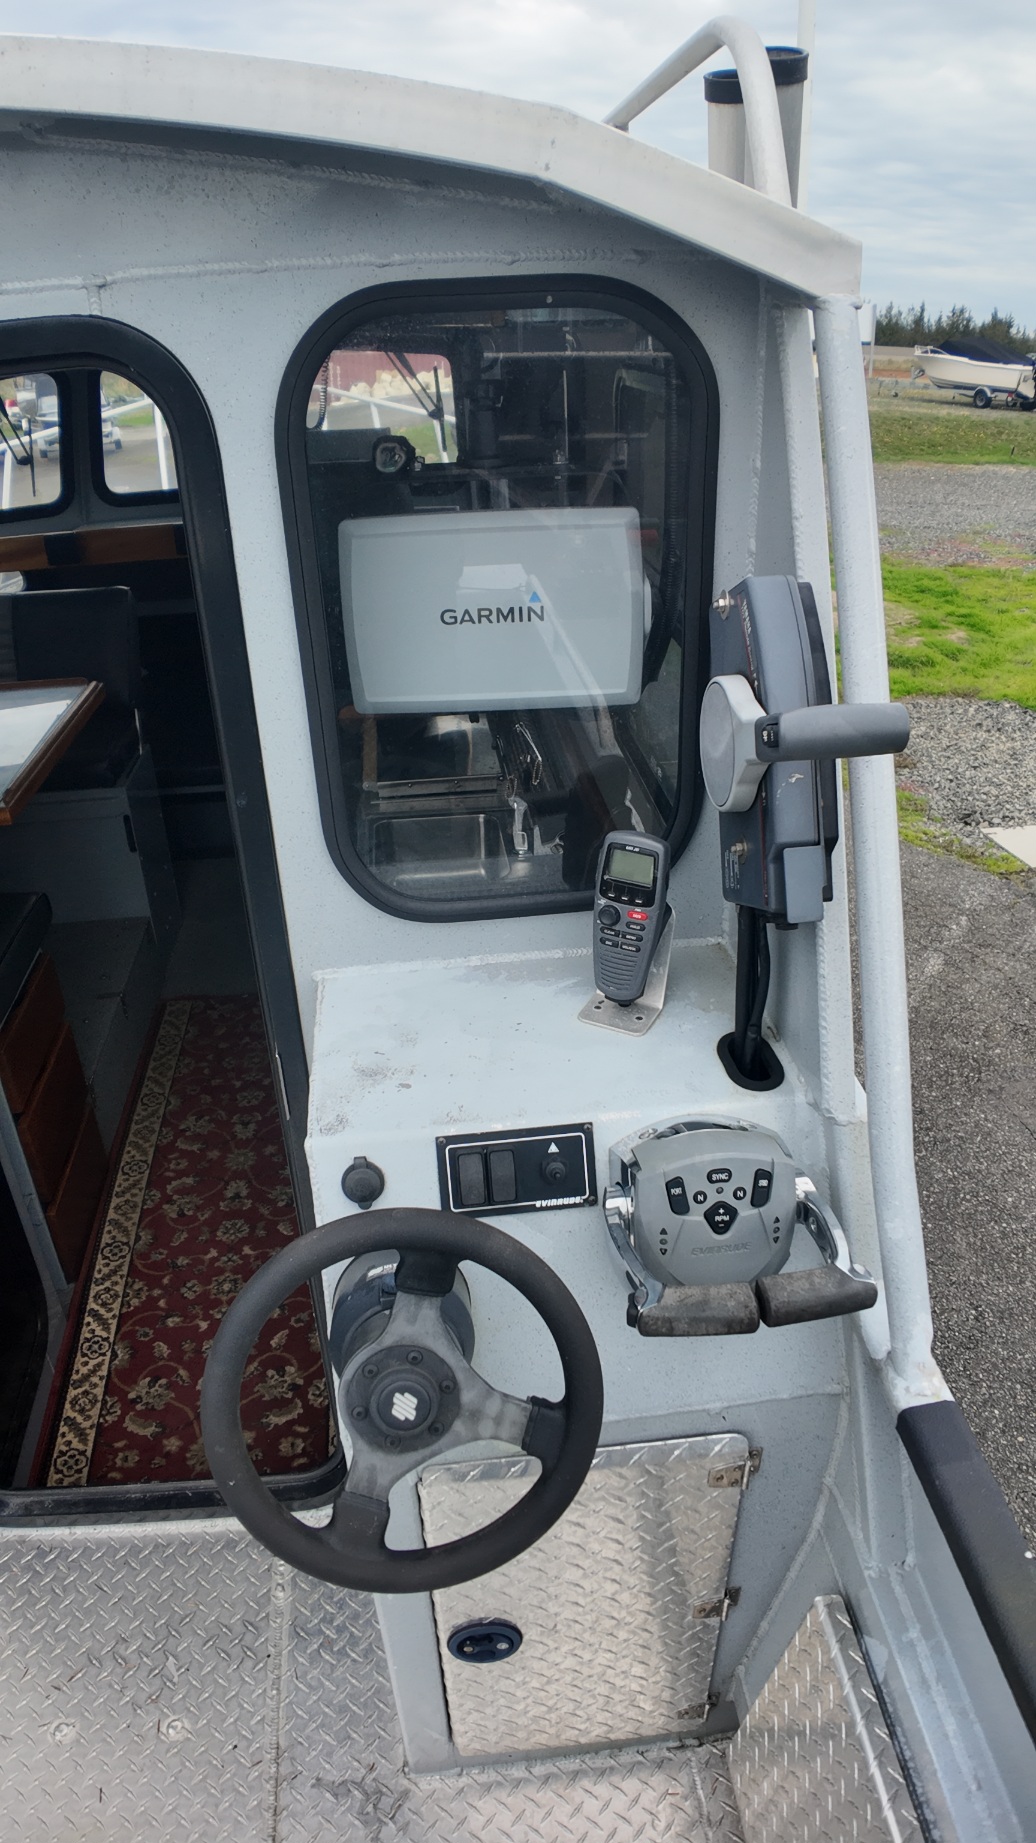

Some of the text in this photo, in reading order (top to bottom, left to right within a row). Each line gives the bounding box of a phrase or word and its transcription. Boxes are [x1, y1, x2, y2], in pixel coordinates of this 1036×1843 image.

[440, 605, 545, 626] GARMIN
[711, 1172, 729, 1181] SYNC
[670, 1187, 682, 1195] PORT
[737, 1190, 744, 1198] N
[697, 1194, 704, 1202] N
